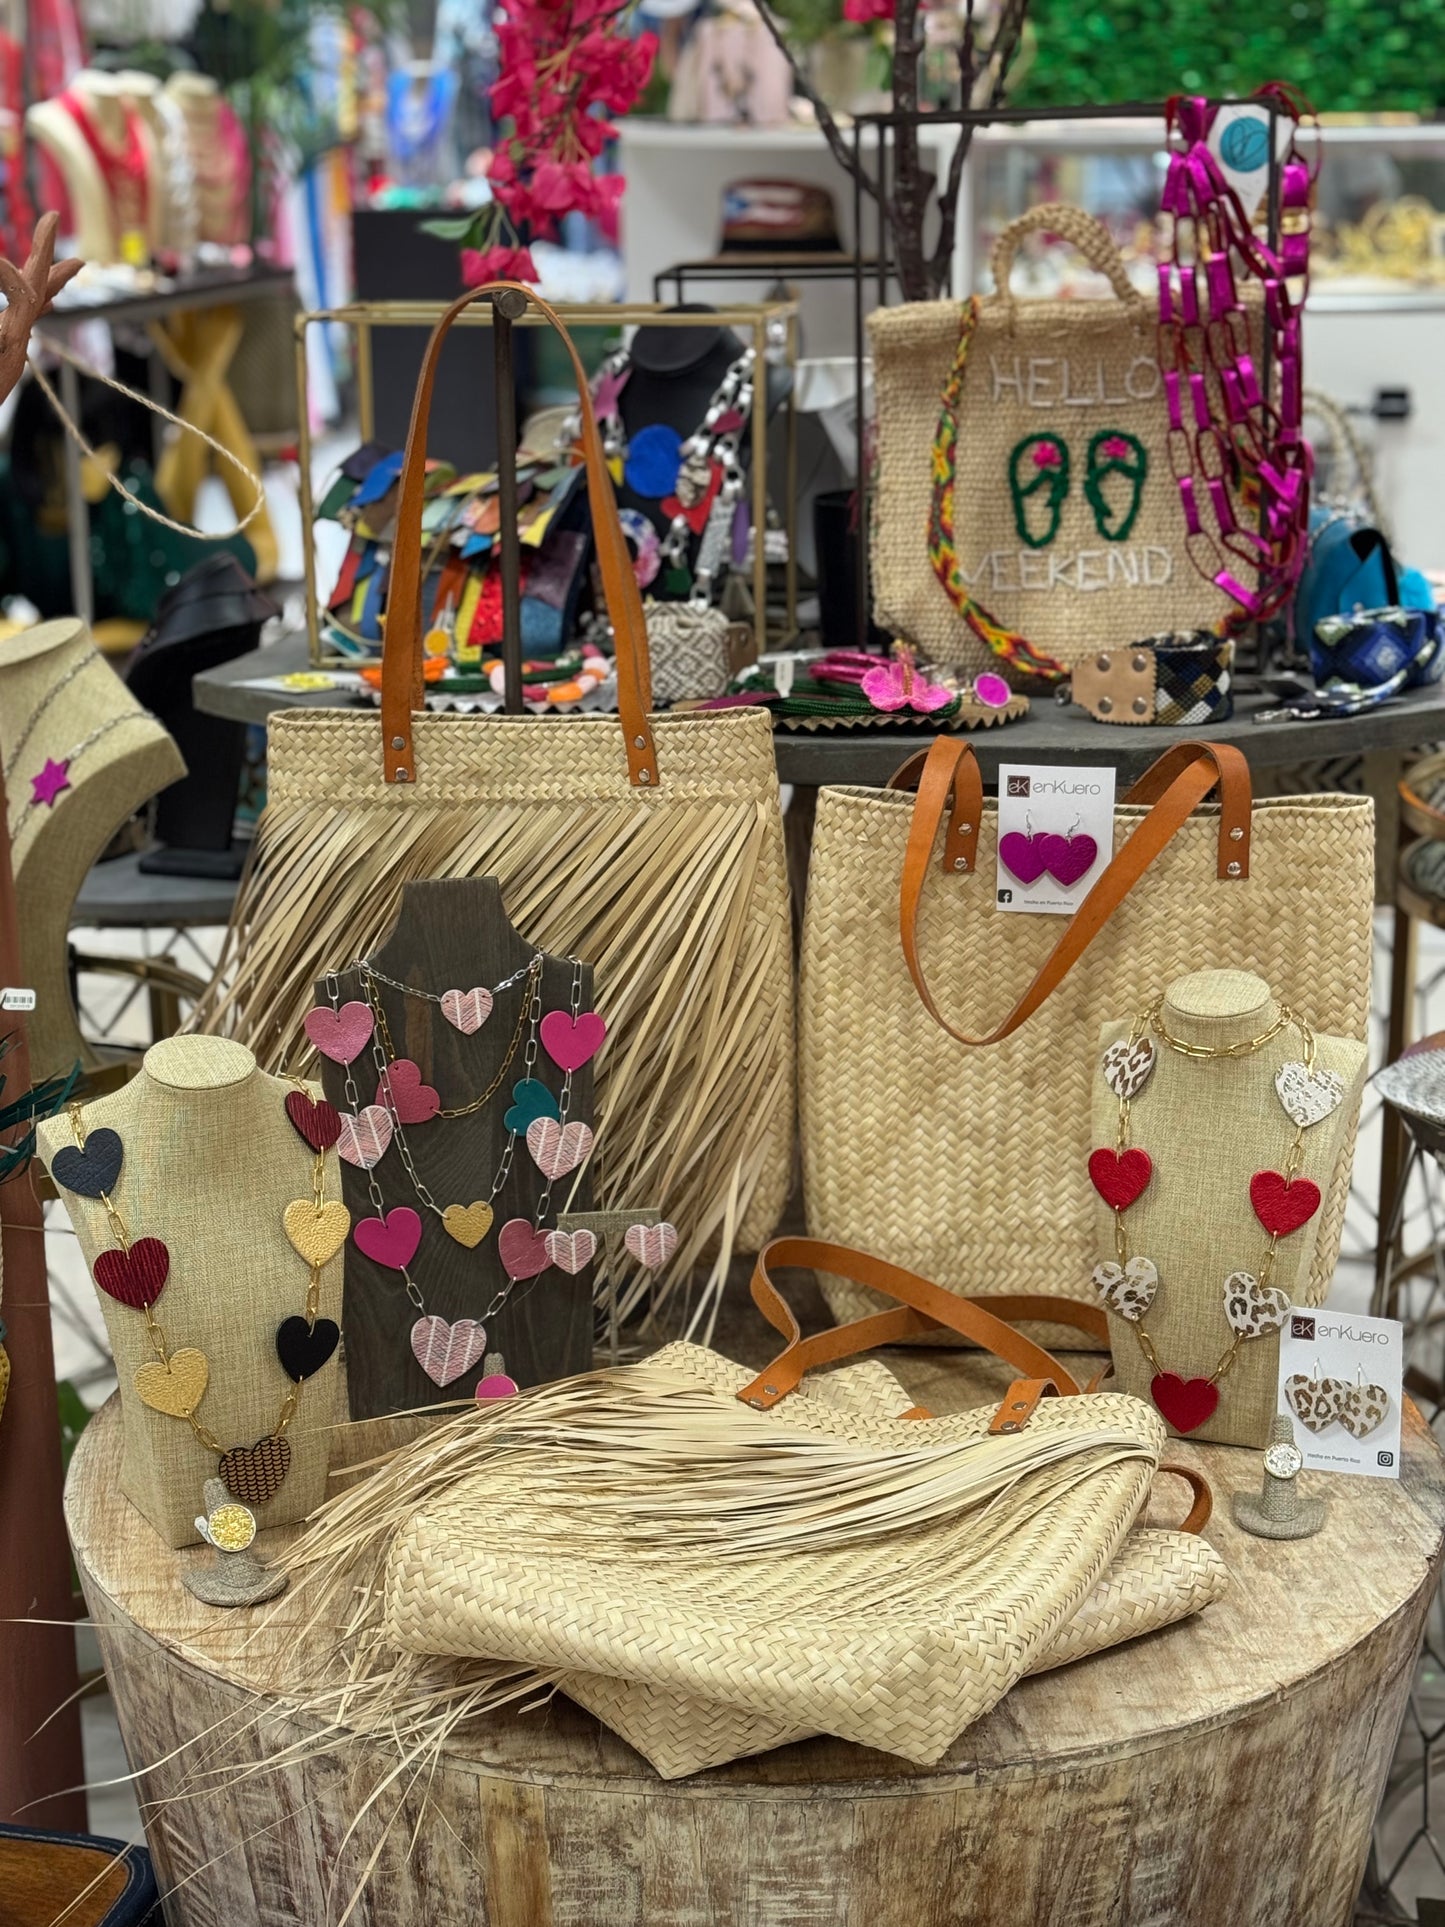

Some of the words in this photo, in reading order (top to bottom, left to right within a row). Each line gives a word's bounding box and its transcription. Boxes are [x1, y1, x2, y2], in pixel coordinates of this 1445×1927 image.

[990, 355, 1161, 406] HELLO
[1032, 780, 1101, 796] enKuero
[1317, 1324, 1390, 1346] enKuero
